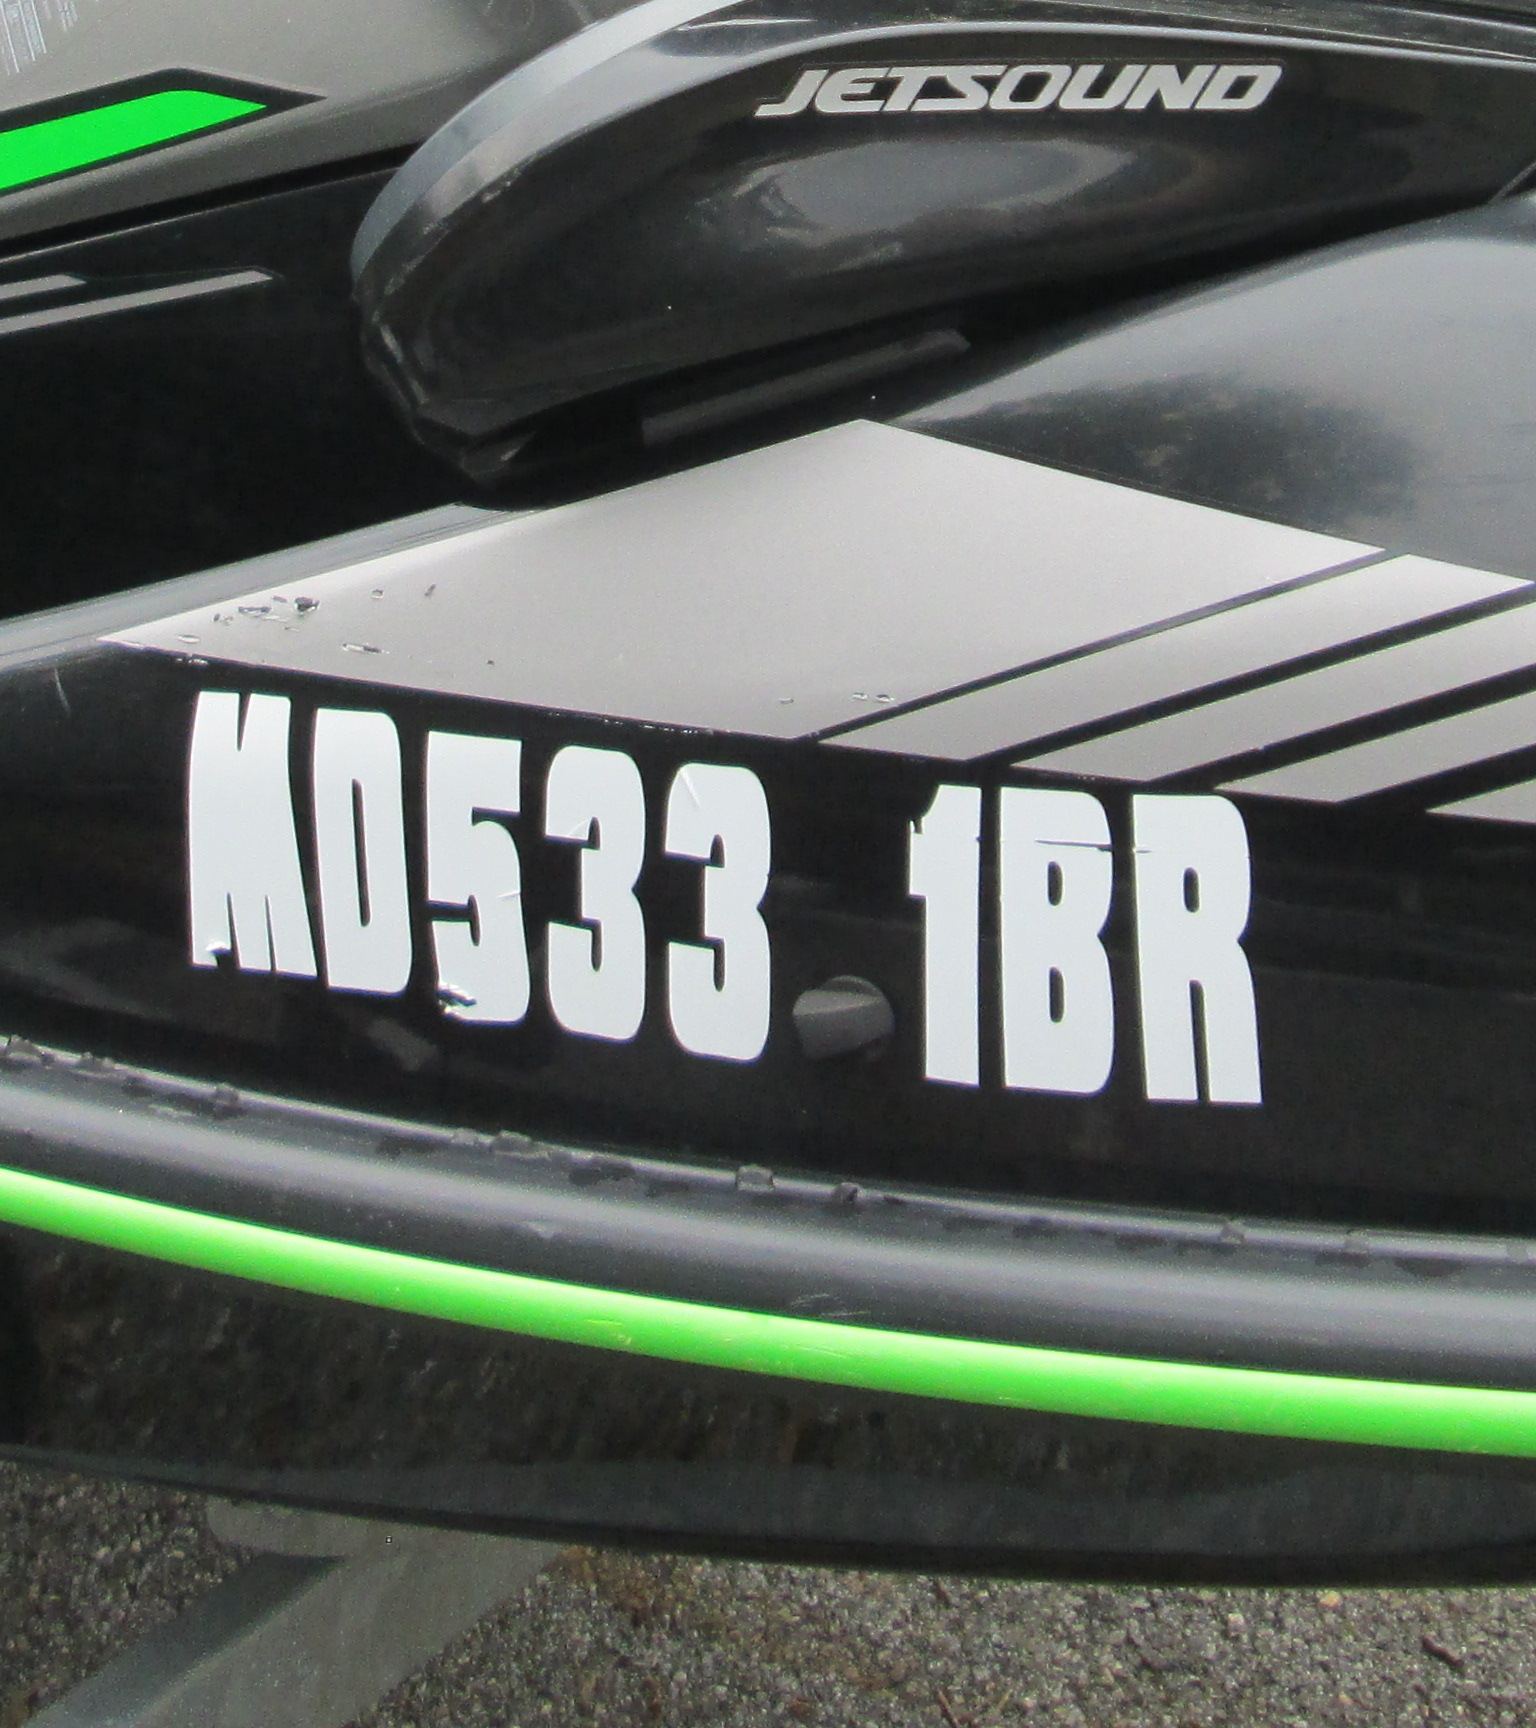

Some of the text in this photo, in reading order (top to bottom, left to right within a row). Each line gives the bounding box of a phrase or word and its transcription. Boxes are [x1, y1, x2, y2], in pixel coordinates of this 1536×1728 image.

[755, 64, 1283, 117] JETSOUND
[188, 690, 1263, 1105] MD533 1BR
